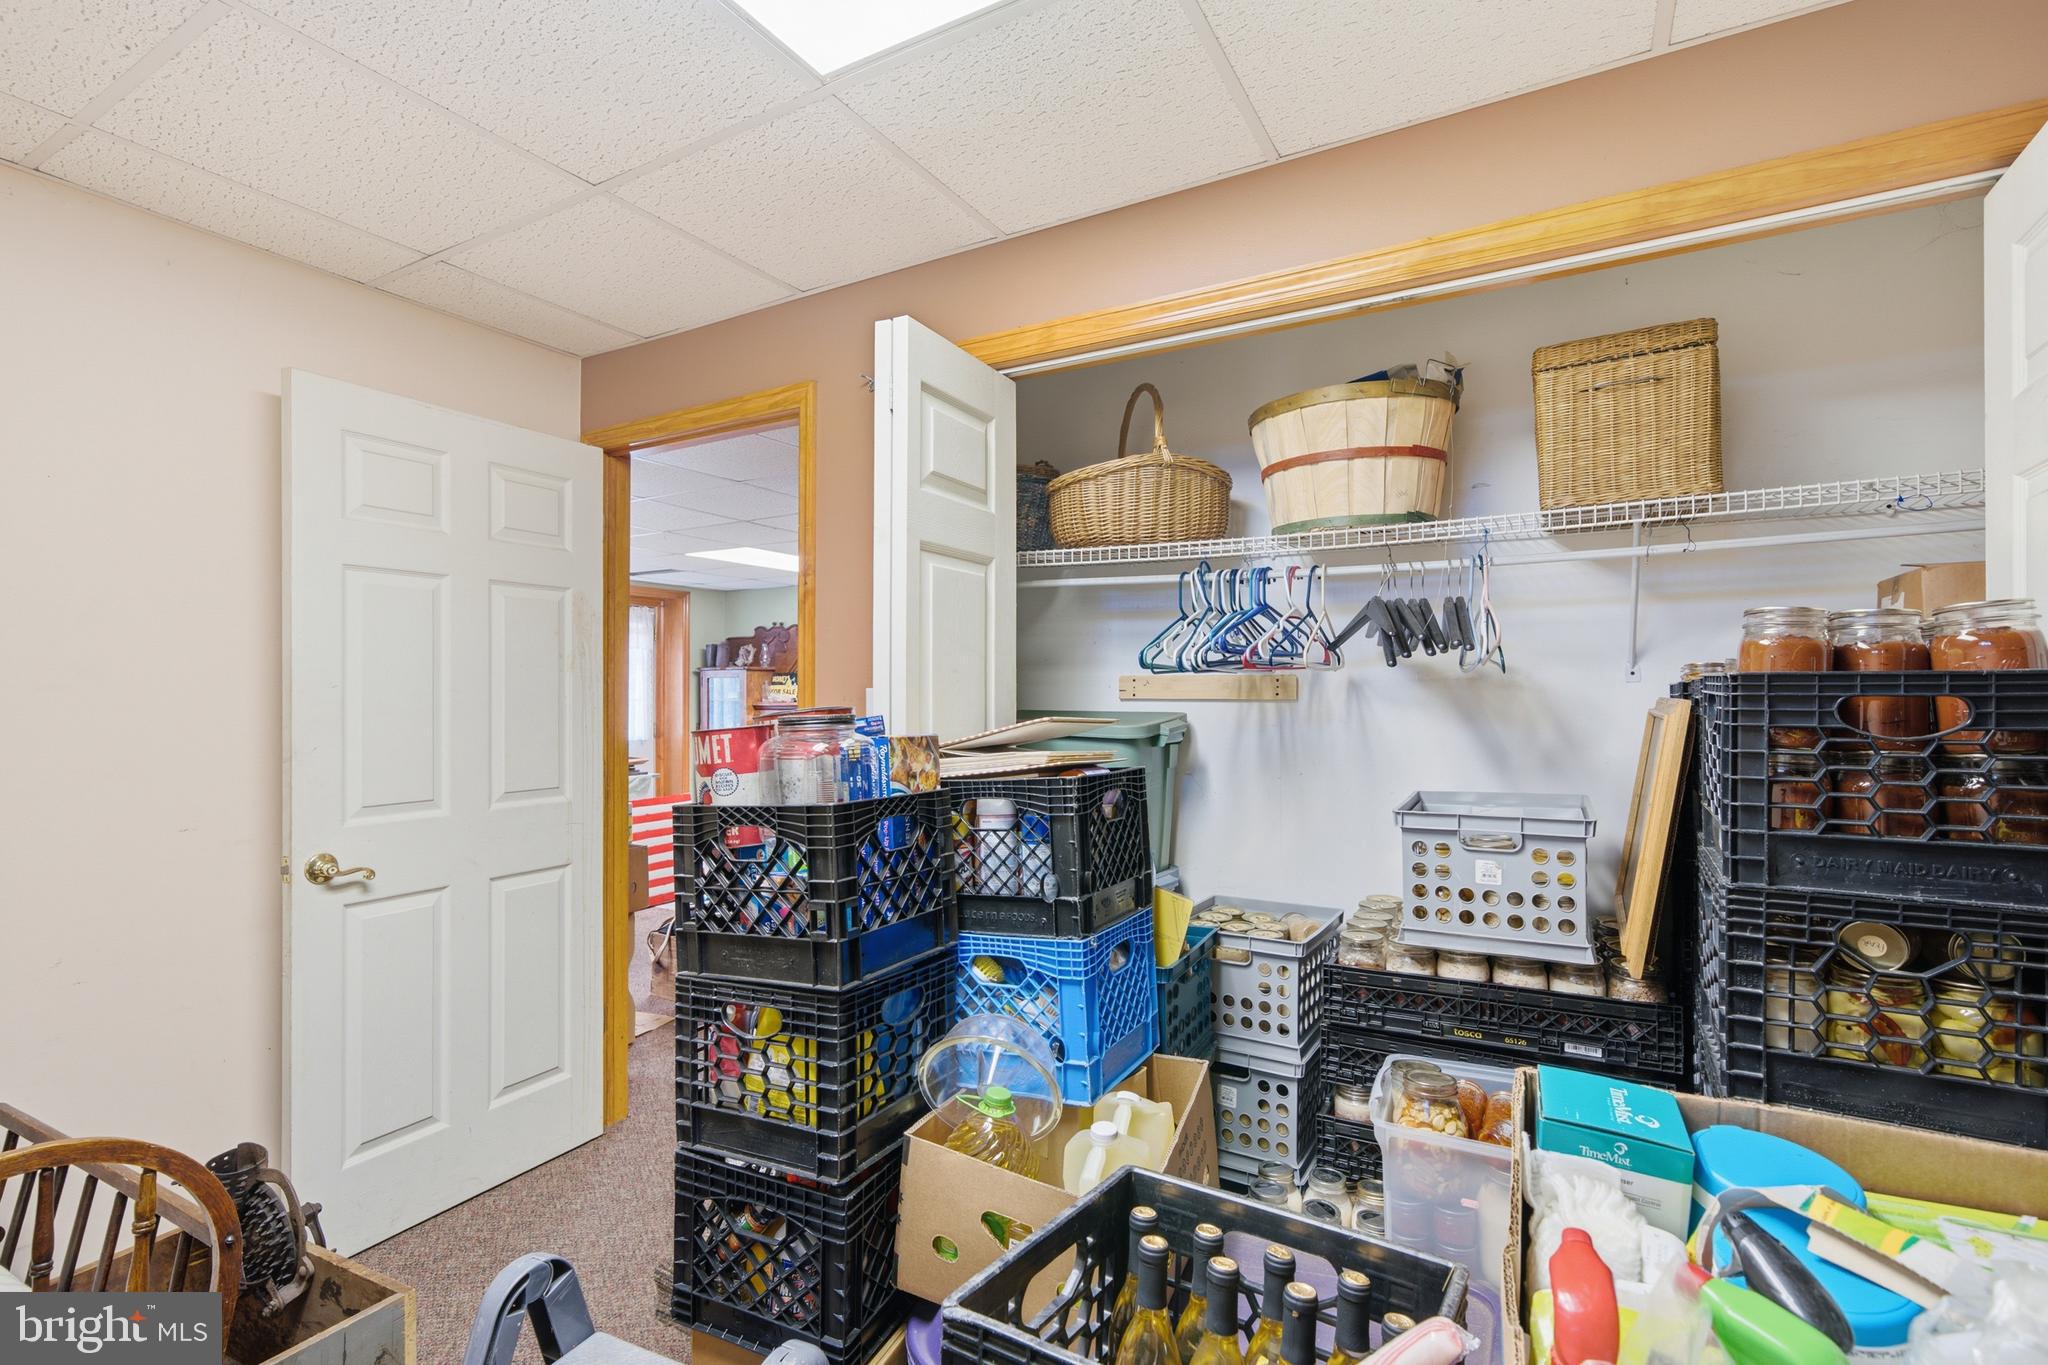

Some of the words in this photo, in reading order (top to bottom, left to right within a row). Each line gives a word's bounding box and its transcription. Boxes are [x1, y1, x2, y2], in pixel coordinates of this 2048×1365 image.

[1812, 855, 1872, 870] DAIRY
[1876, 860, 1926, 876] MAID
[1931, 863, 1997, 880] DAIRY
[1453, 1027, 1483, 1039] tosca
[1579, 1145, 1632, 1167] TimeMist
